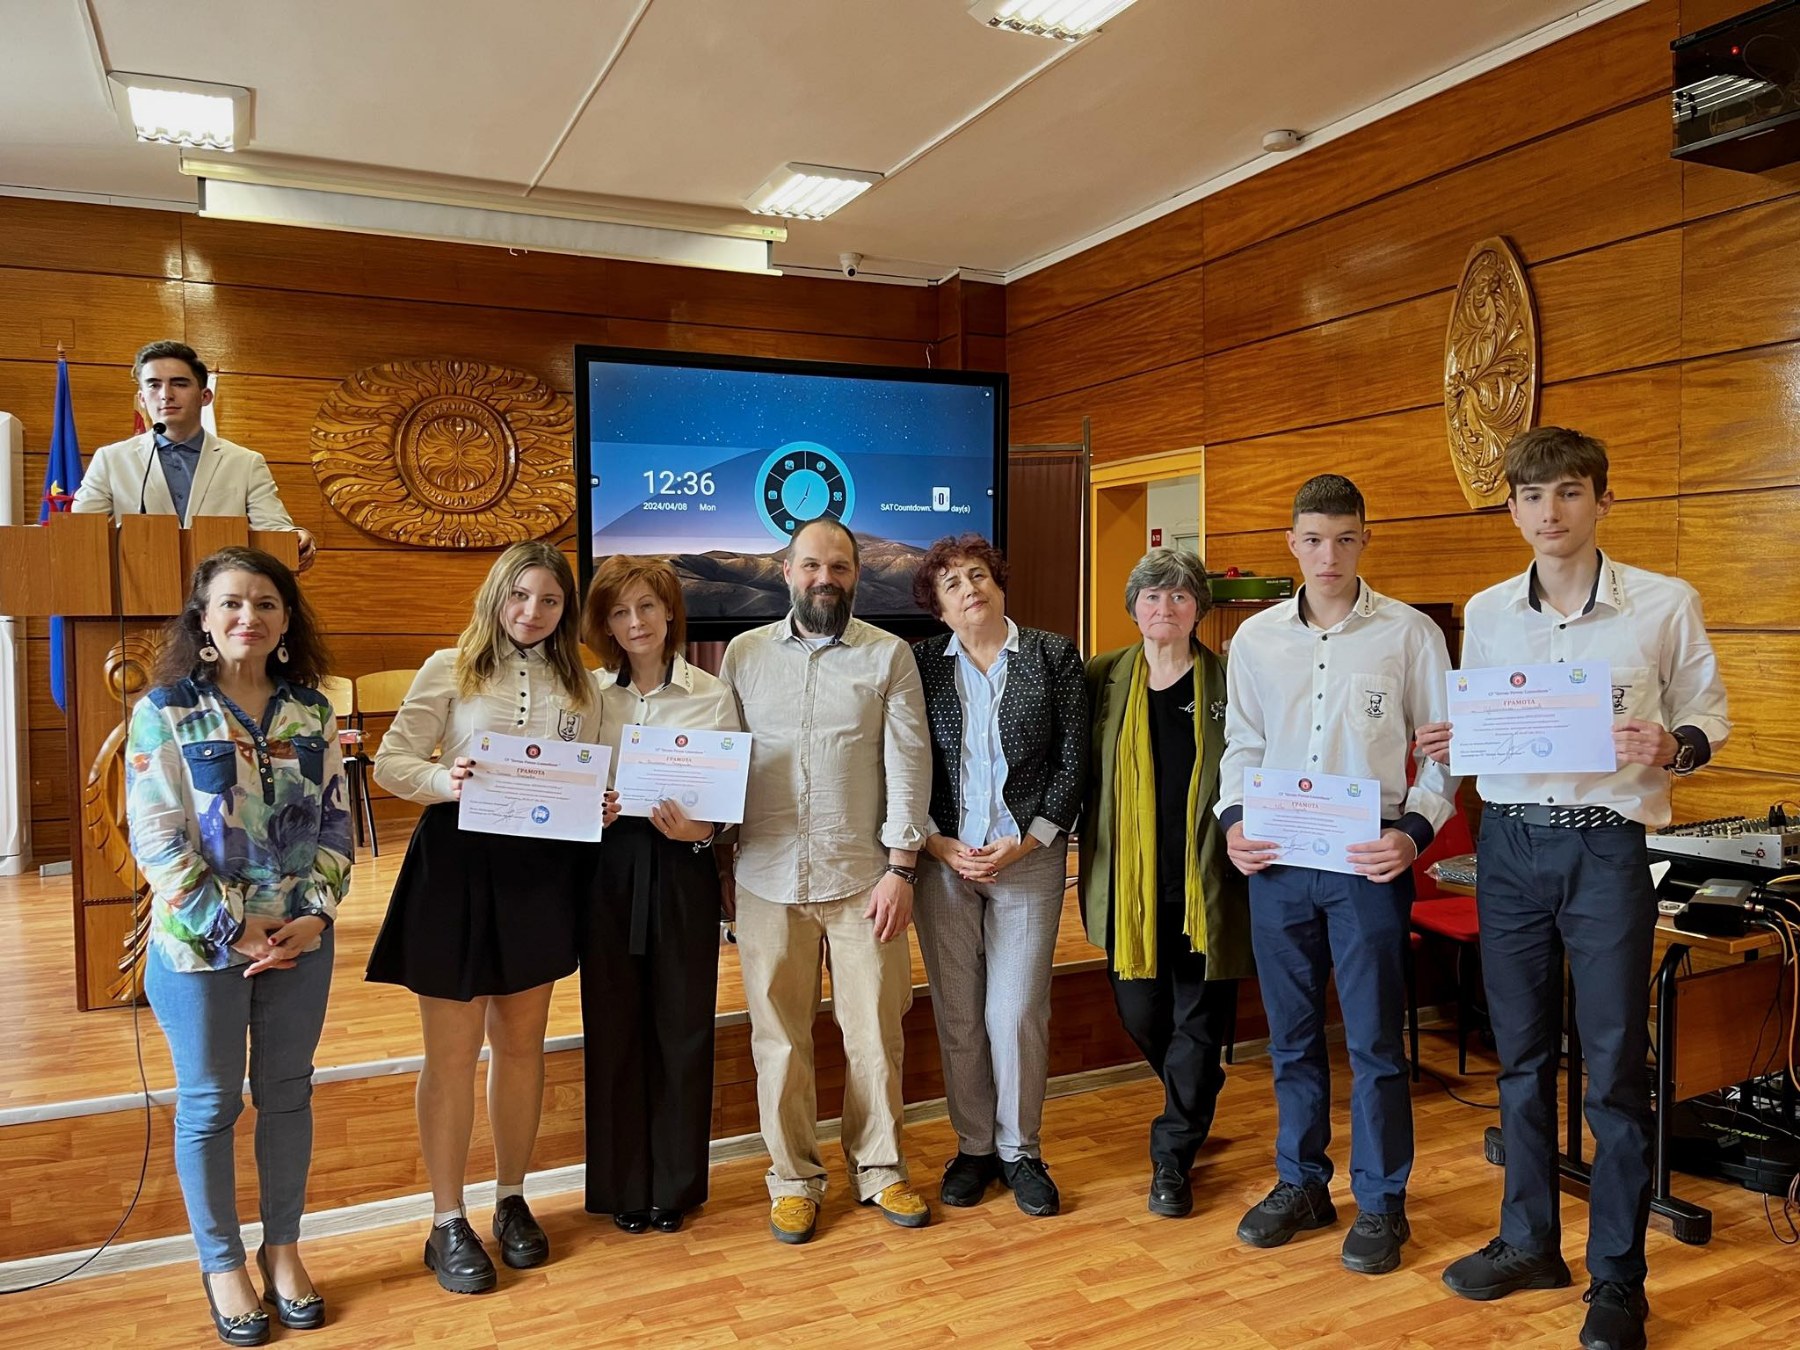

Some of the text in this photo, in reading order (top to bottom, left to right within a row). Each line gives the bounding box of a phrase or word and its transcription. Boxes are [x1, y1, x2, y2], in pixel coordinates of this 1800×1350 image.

[643, 470, 716, 496] 12:36
[643, 502, 717, 512] 2024/04/08 Mon
[951, 505, 971, 514] day(s)
[1503, 699, 1536, 707] ГРАМОТА
[516, 767, 545, 776] ГРАМОТА
